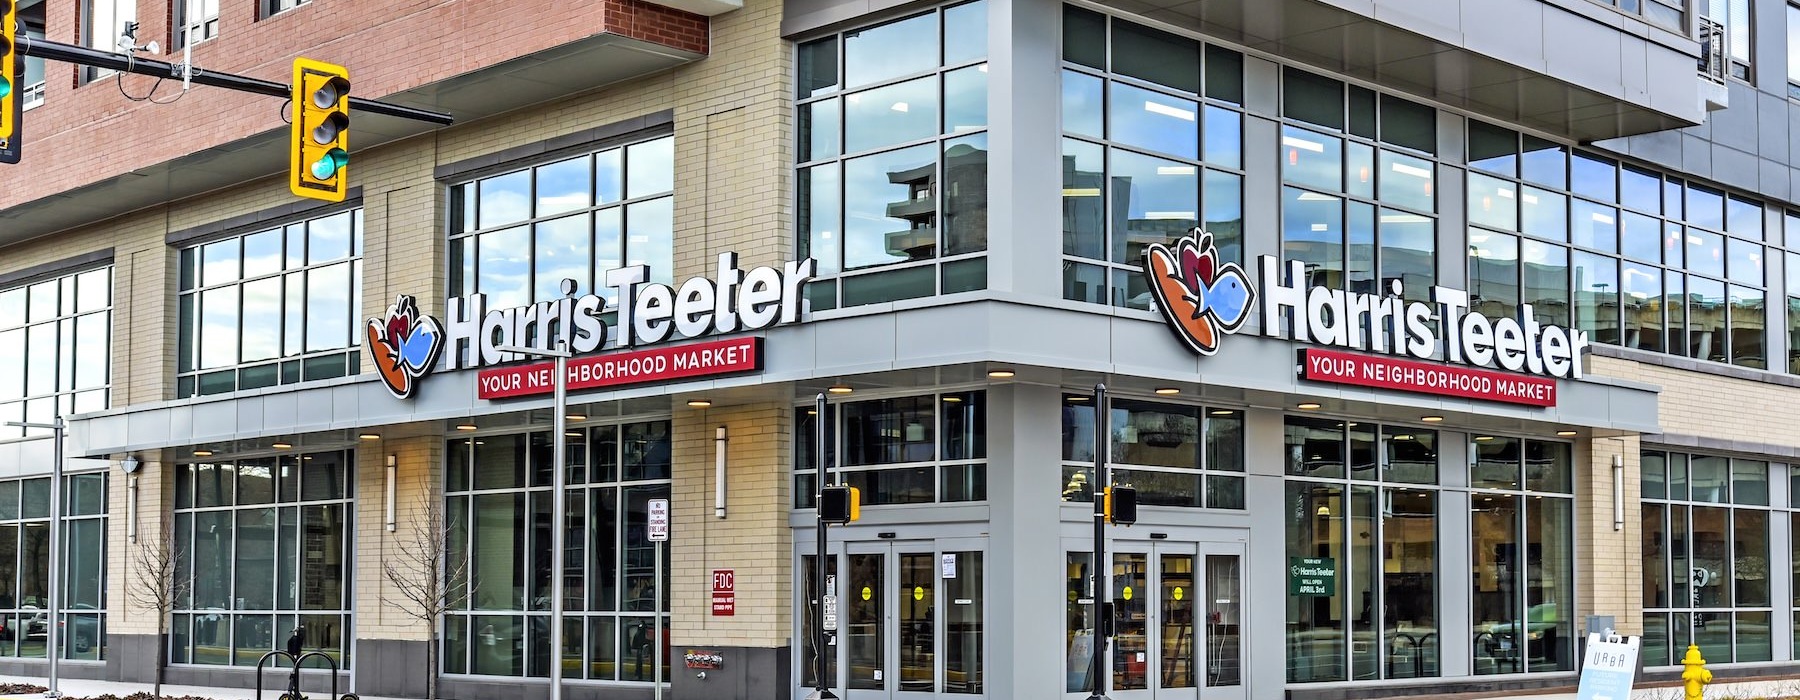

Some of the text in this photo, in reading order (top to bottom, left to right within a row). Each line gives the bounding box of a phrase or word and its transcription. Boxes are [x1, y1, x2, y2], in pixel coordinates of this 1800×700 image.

[446, 251, 816, 369] Harris Teeter
[1259, 255, 1588, 379] Harris Teeter
[481, 344, 751, 393] YOUR NEIHBORHOOD MARKET
[1311, 355, 1553, 401] YOUR NEIGHBORHOOD MARKET
[713, 573, 733, 589] FDC
[1300, 567, 1334, 576] Harris Teeter
[1593, 652, 1626, 668] URBA
